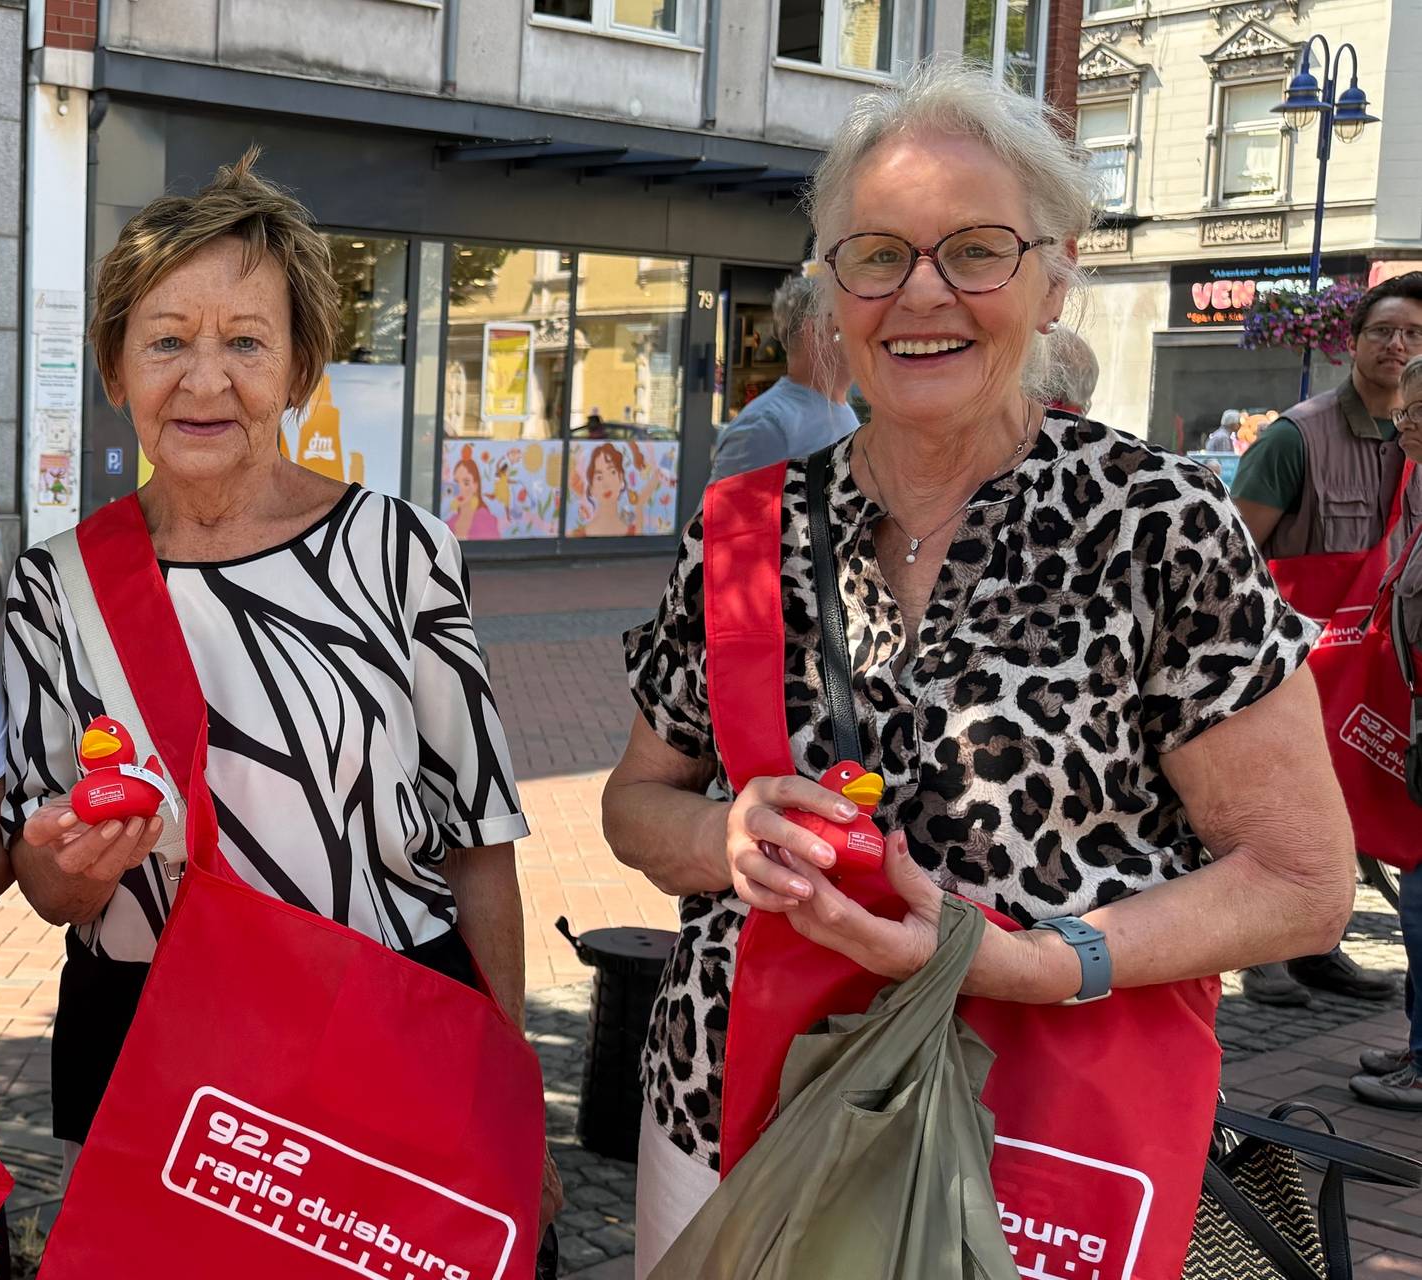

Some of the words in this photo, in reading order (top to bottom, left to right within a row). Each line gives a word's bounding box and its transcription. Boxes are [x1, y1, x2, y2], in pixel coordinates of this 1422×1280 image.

[698, 289, 714, 309] 79
[308, 431, 333, 452] dm
[1360, 713, 1395, 744] 92.2
[207, 1111, 311, 1177] 92.2
[194, 1153, 294, 1207] radio
[996, 1202, 1107, 1263] burg
